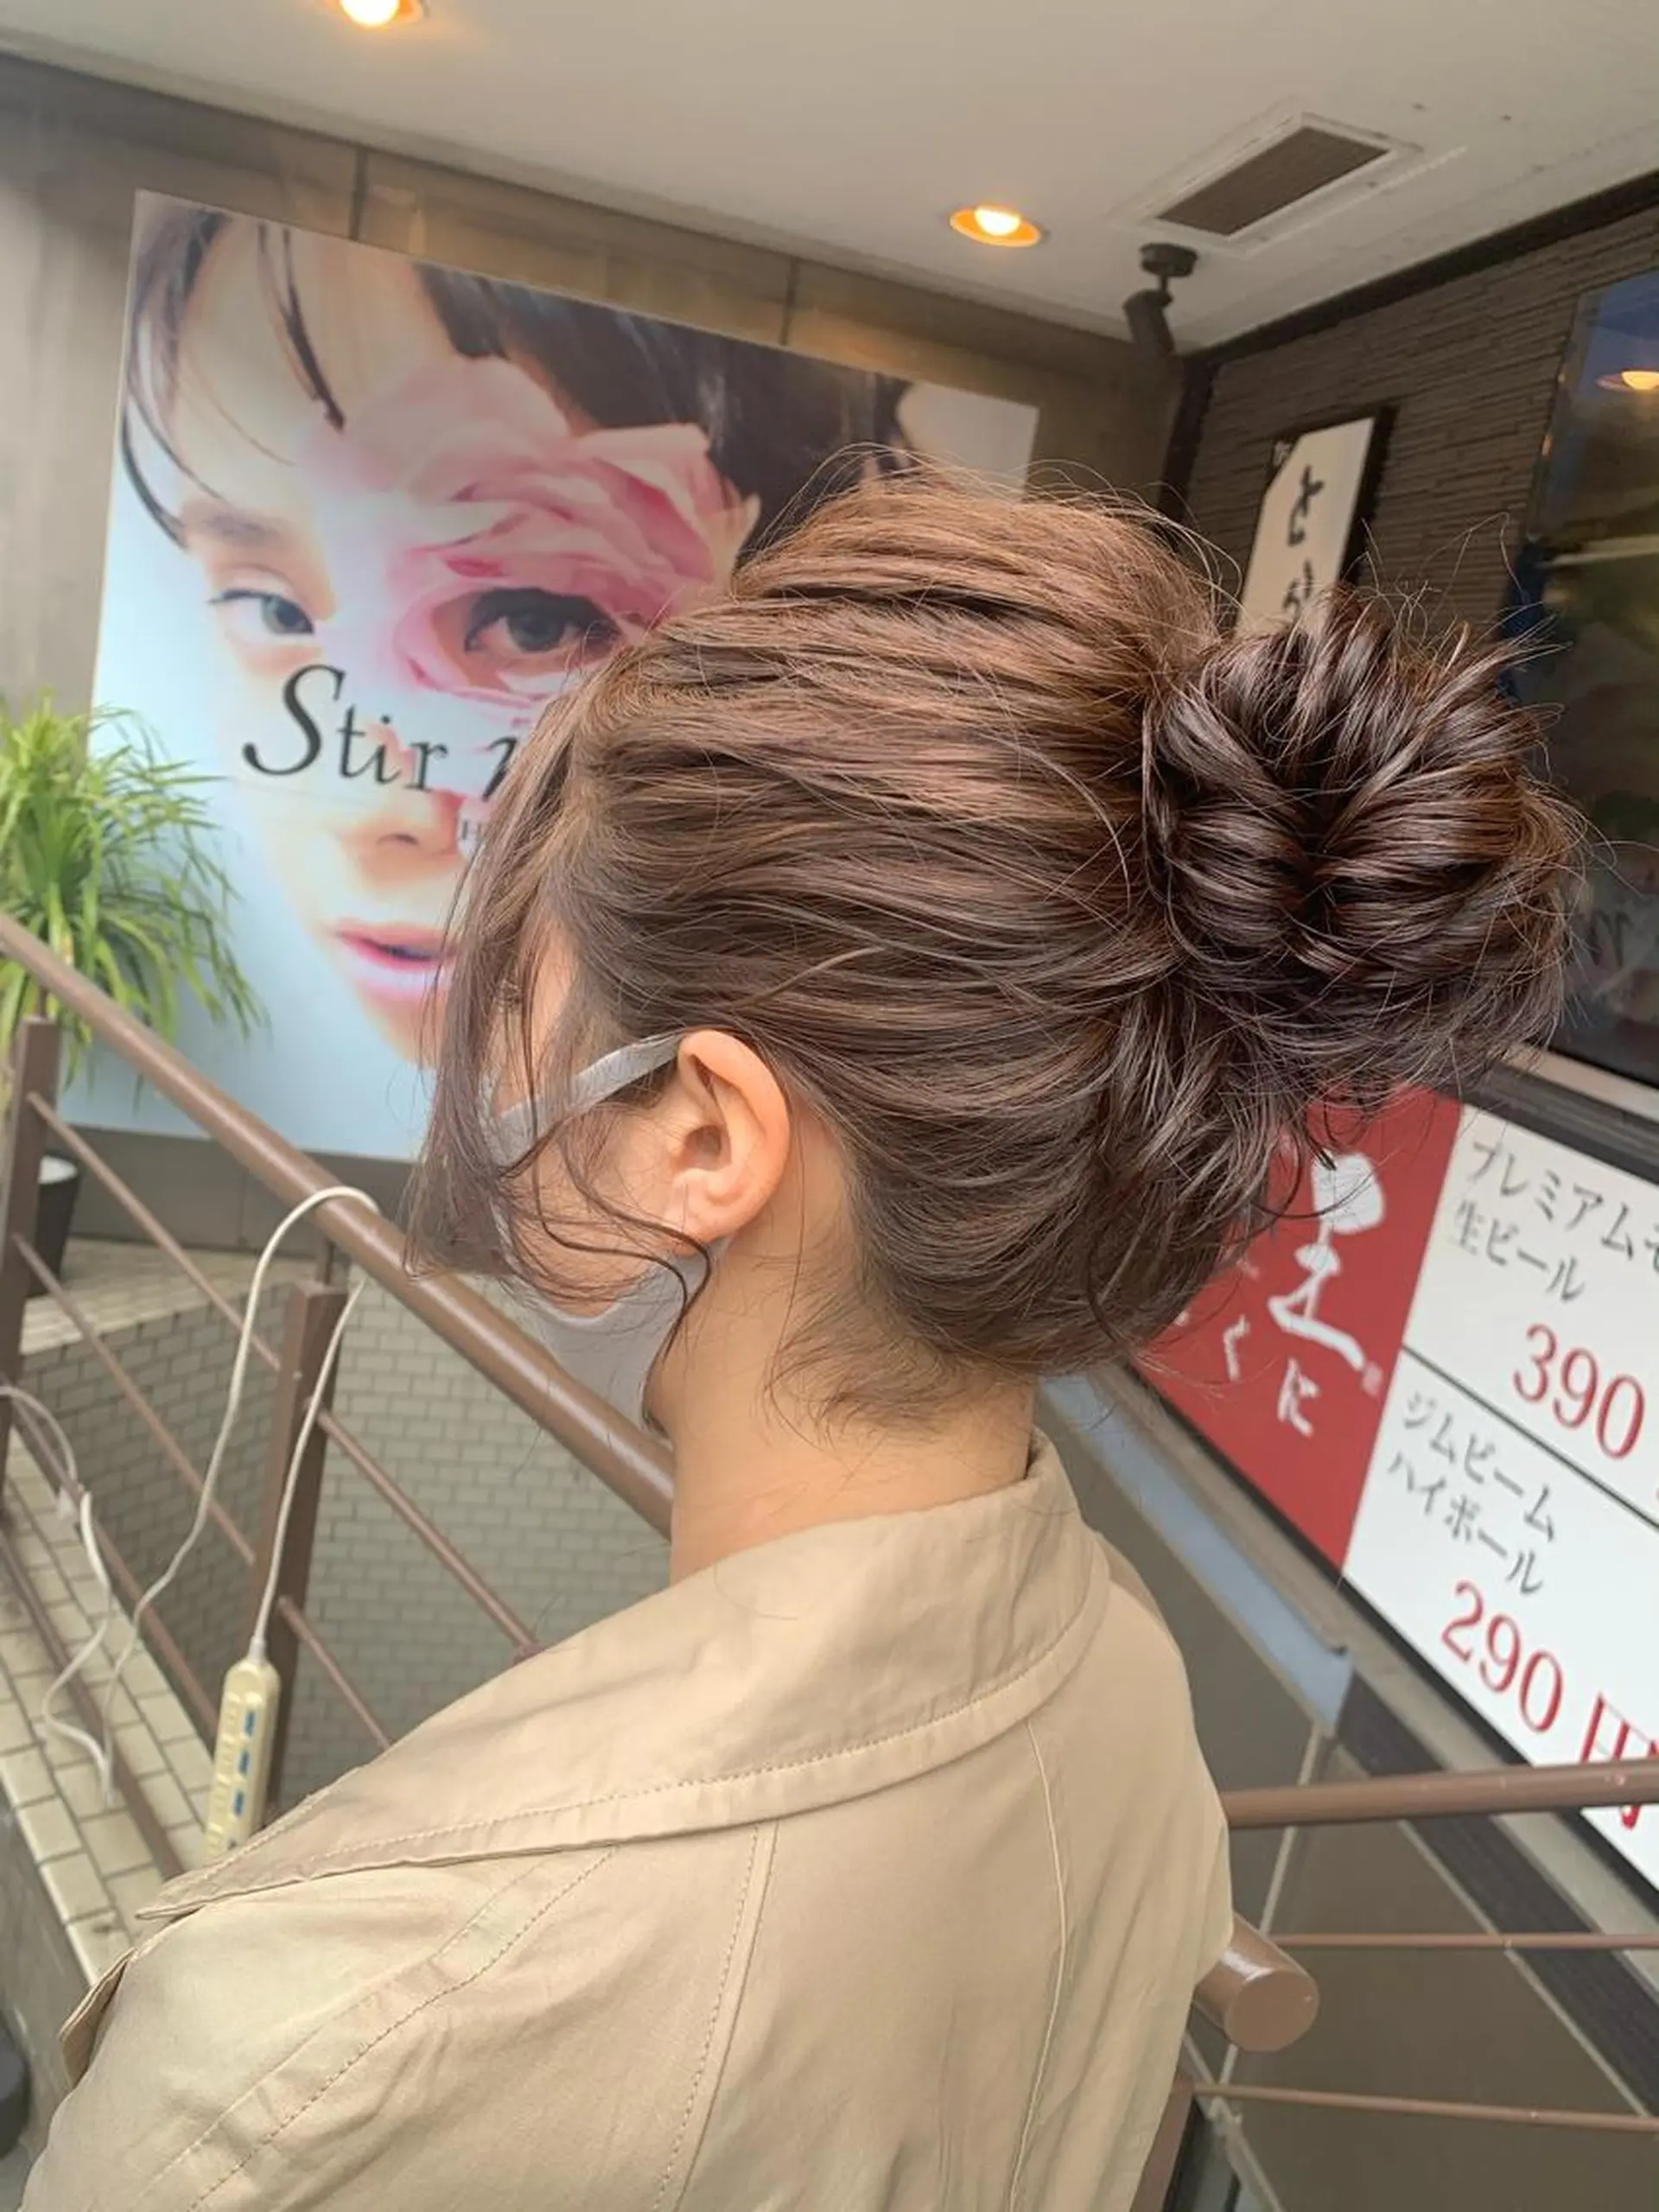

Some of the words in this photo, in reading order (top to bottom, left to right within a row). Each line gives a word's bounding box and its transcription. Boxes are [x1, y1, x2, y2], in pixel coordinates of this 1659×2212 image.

[242, 664, 448, 792] Stir
[1450, 1198, 1586, 1303] 生ビール
[1513, 1322, 1646, 1460] 390
[1387, 1451, 1544, 1595] ハイボール
[1402, 1390, 1554, 1543] ジムビーム
